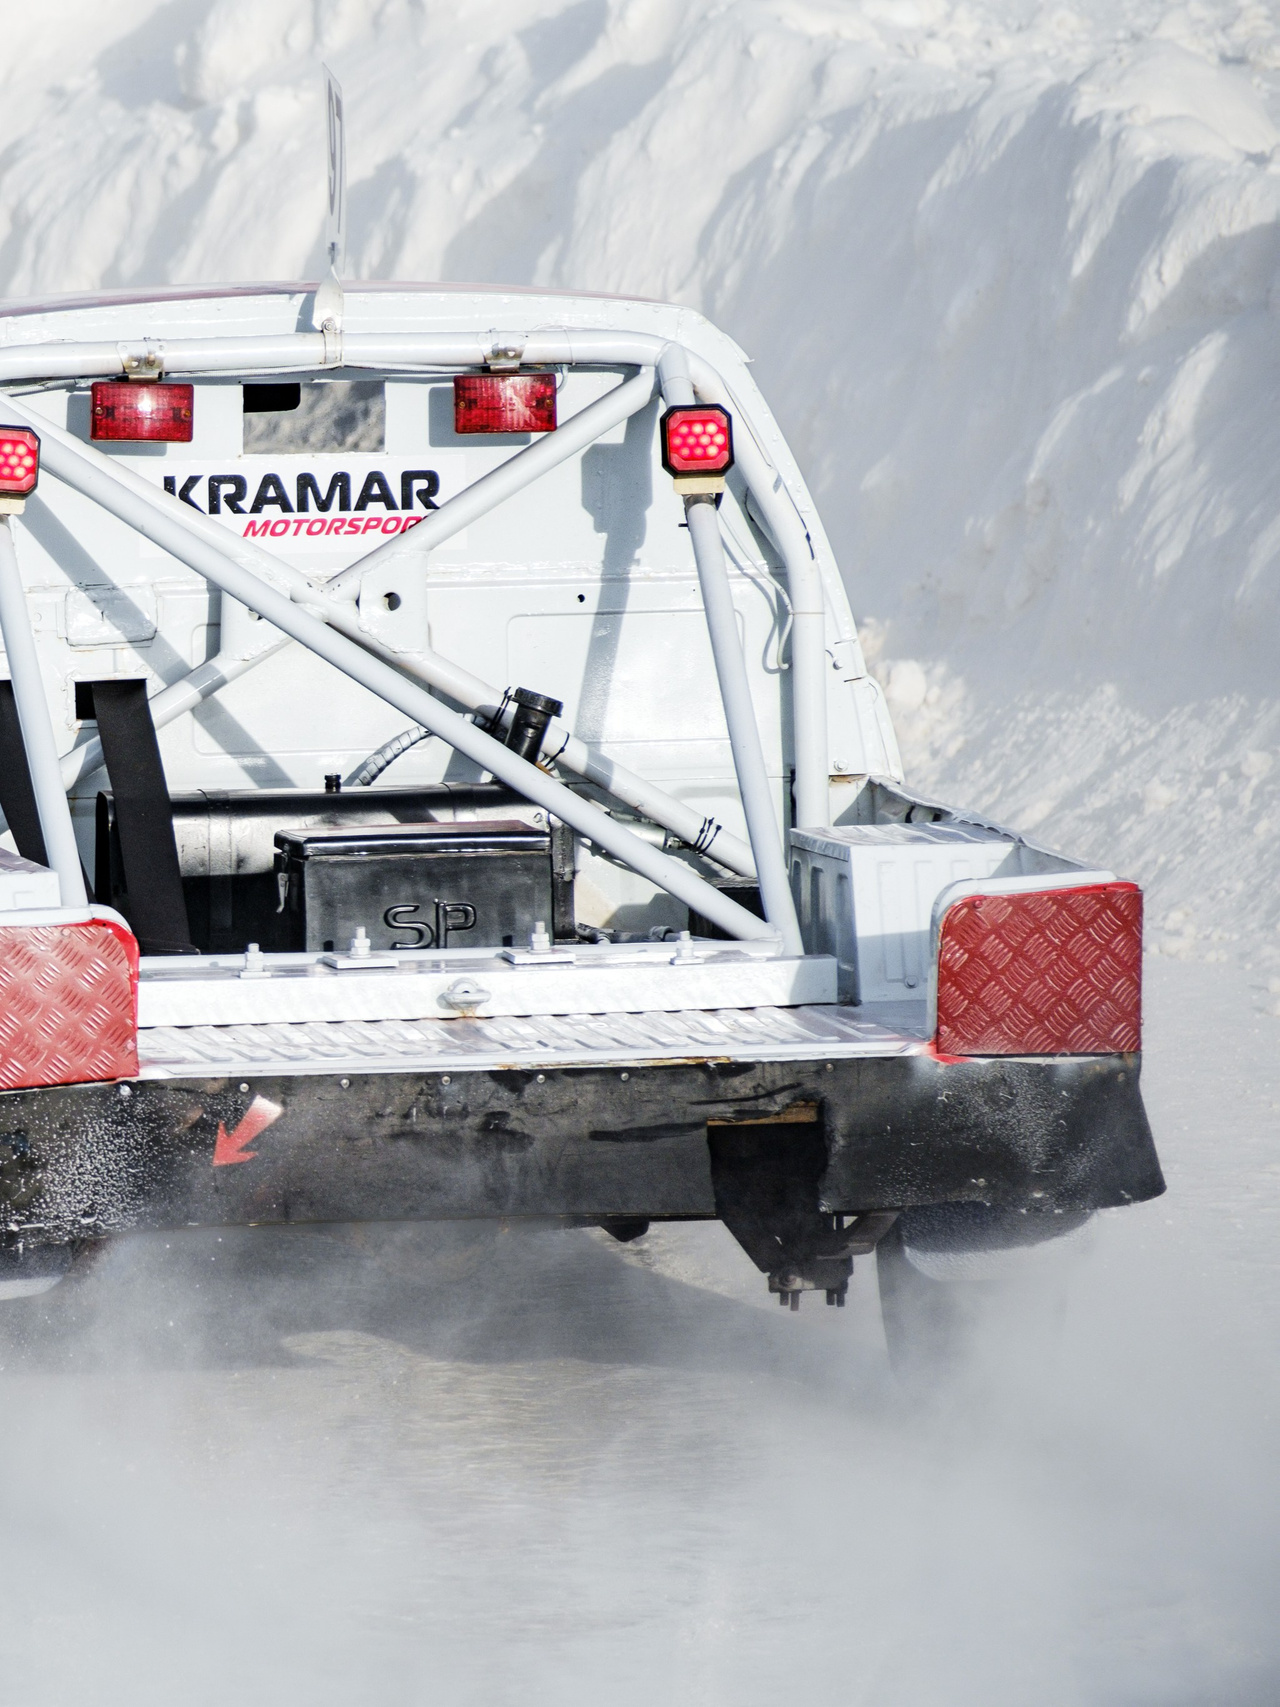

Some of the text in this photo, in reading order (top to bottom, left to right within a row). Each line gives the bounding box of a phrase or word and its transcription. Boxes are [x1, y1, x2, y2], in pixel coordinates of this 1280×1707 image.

[327, 78, 343, 234] 97
[163, 469, 441, 516] KRAMAR
[242, 515, 428, 538] MOTORSPOR
